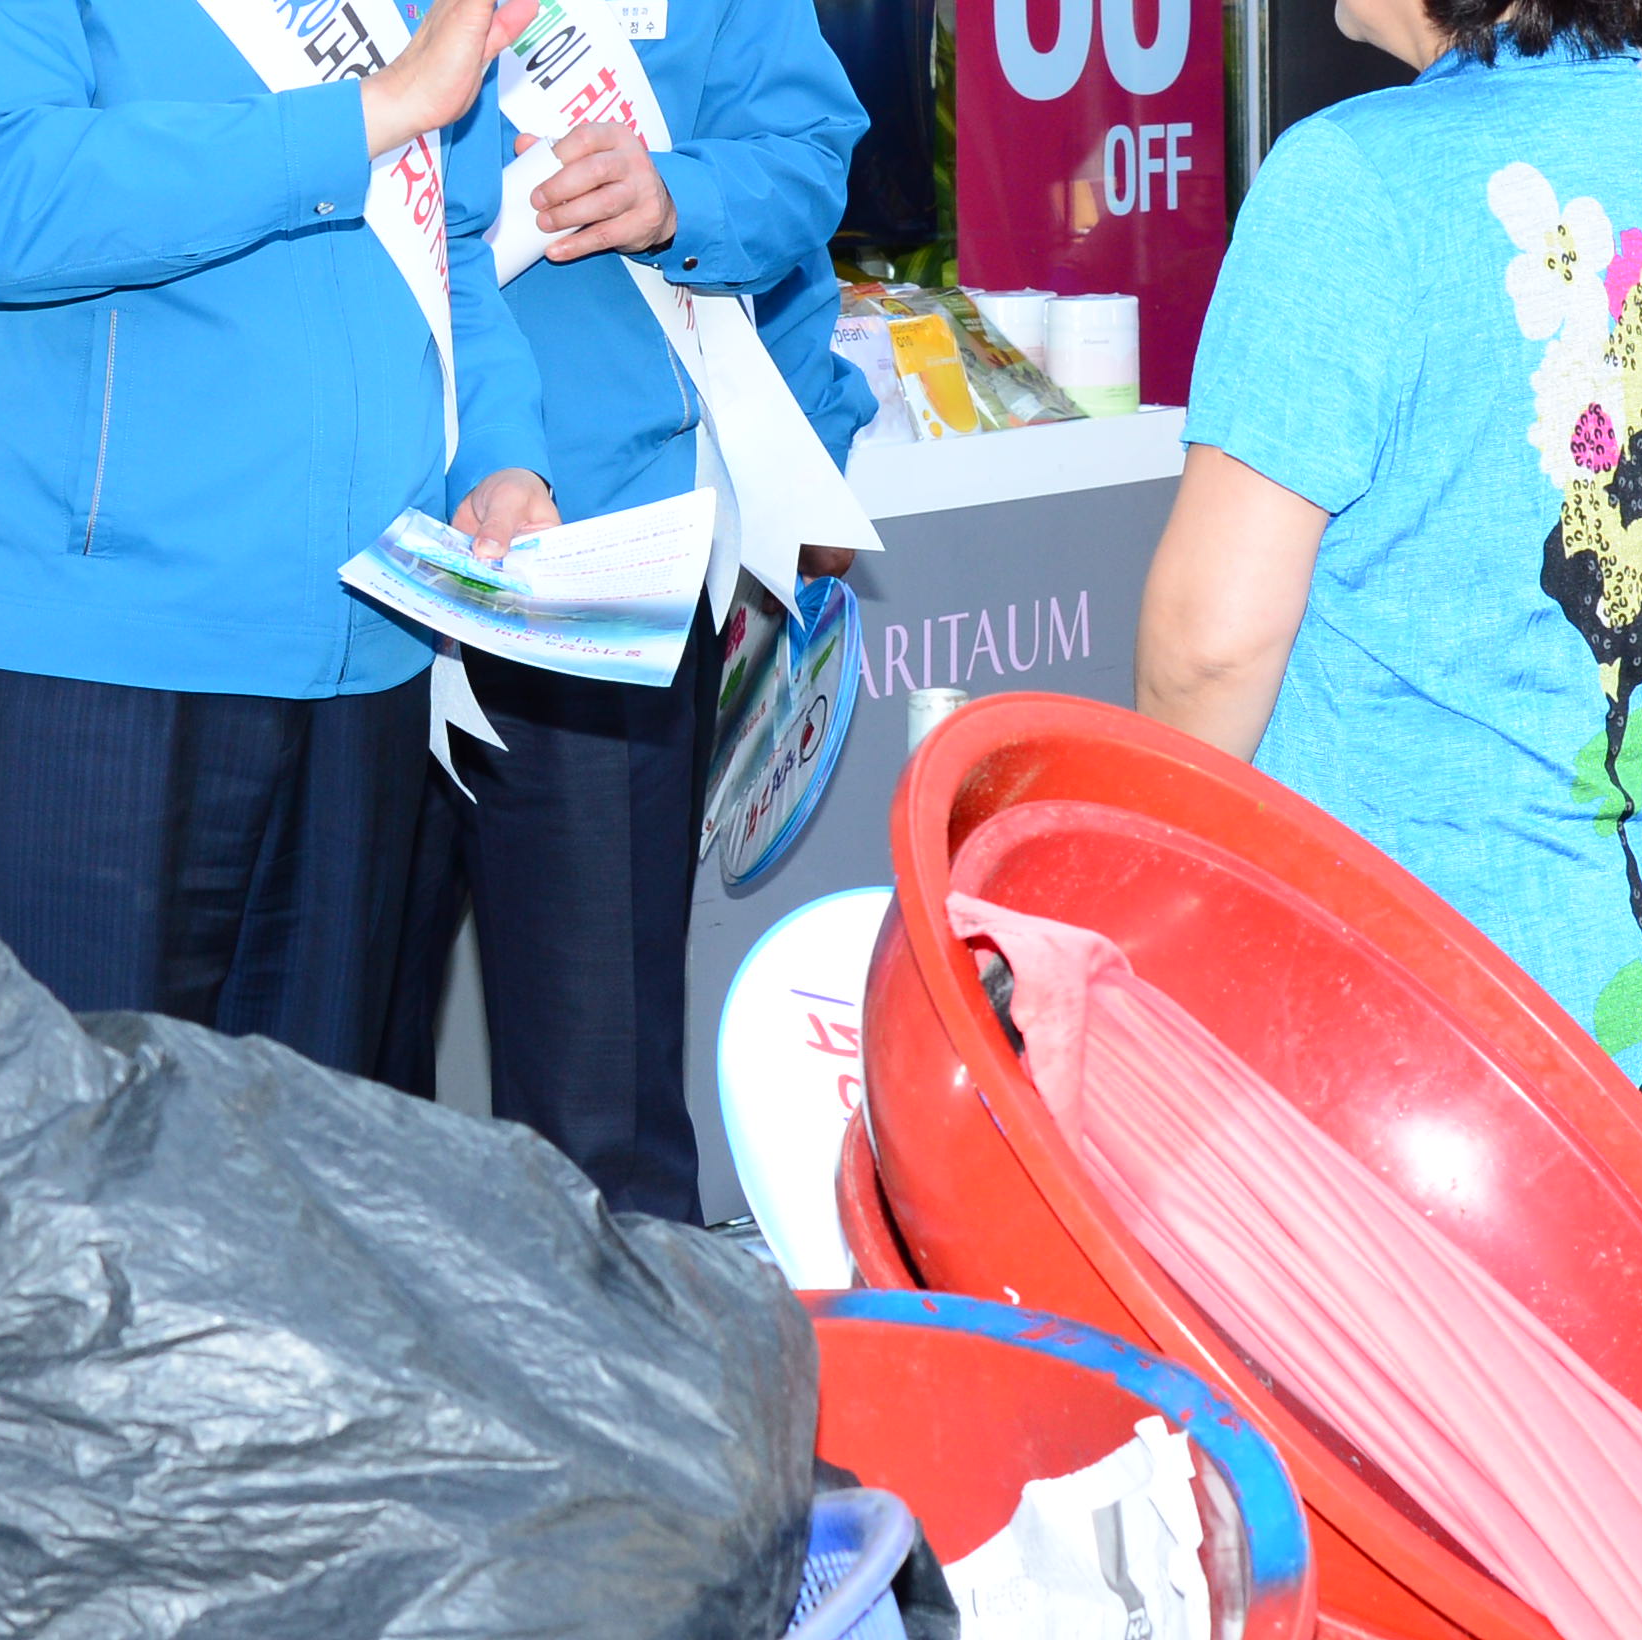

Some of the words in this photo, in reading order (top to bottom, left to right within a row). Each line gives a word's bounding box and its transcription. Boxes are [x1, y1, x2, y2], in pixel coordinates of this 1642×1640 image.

[1104, 122, 1193, 217] OFF
[834, 325, 868, 347] pearl
[897, 335, 913, 349] Q10
